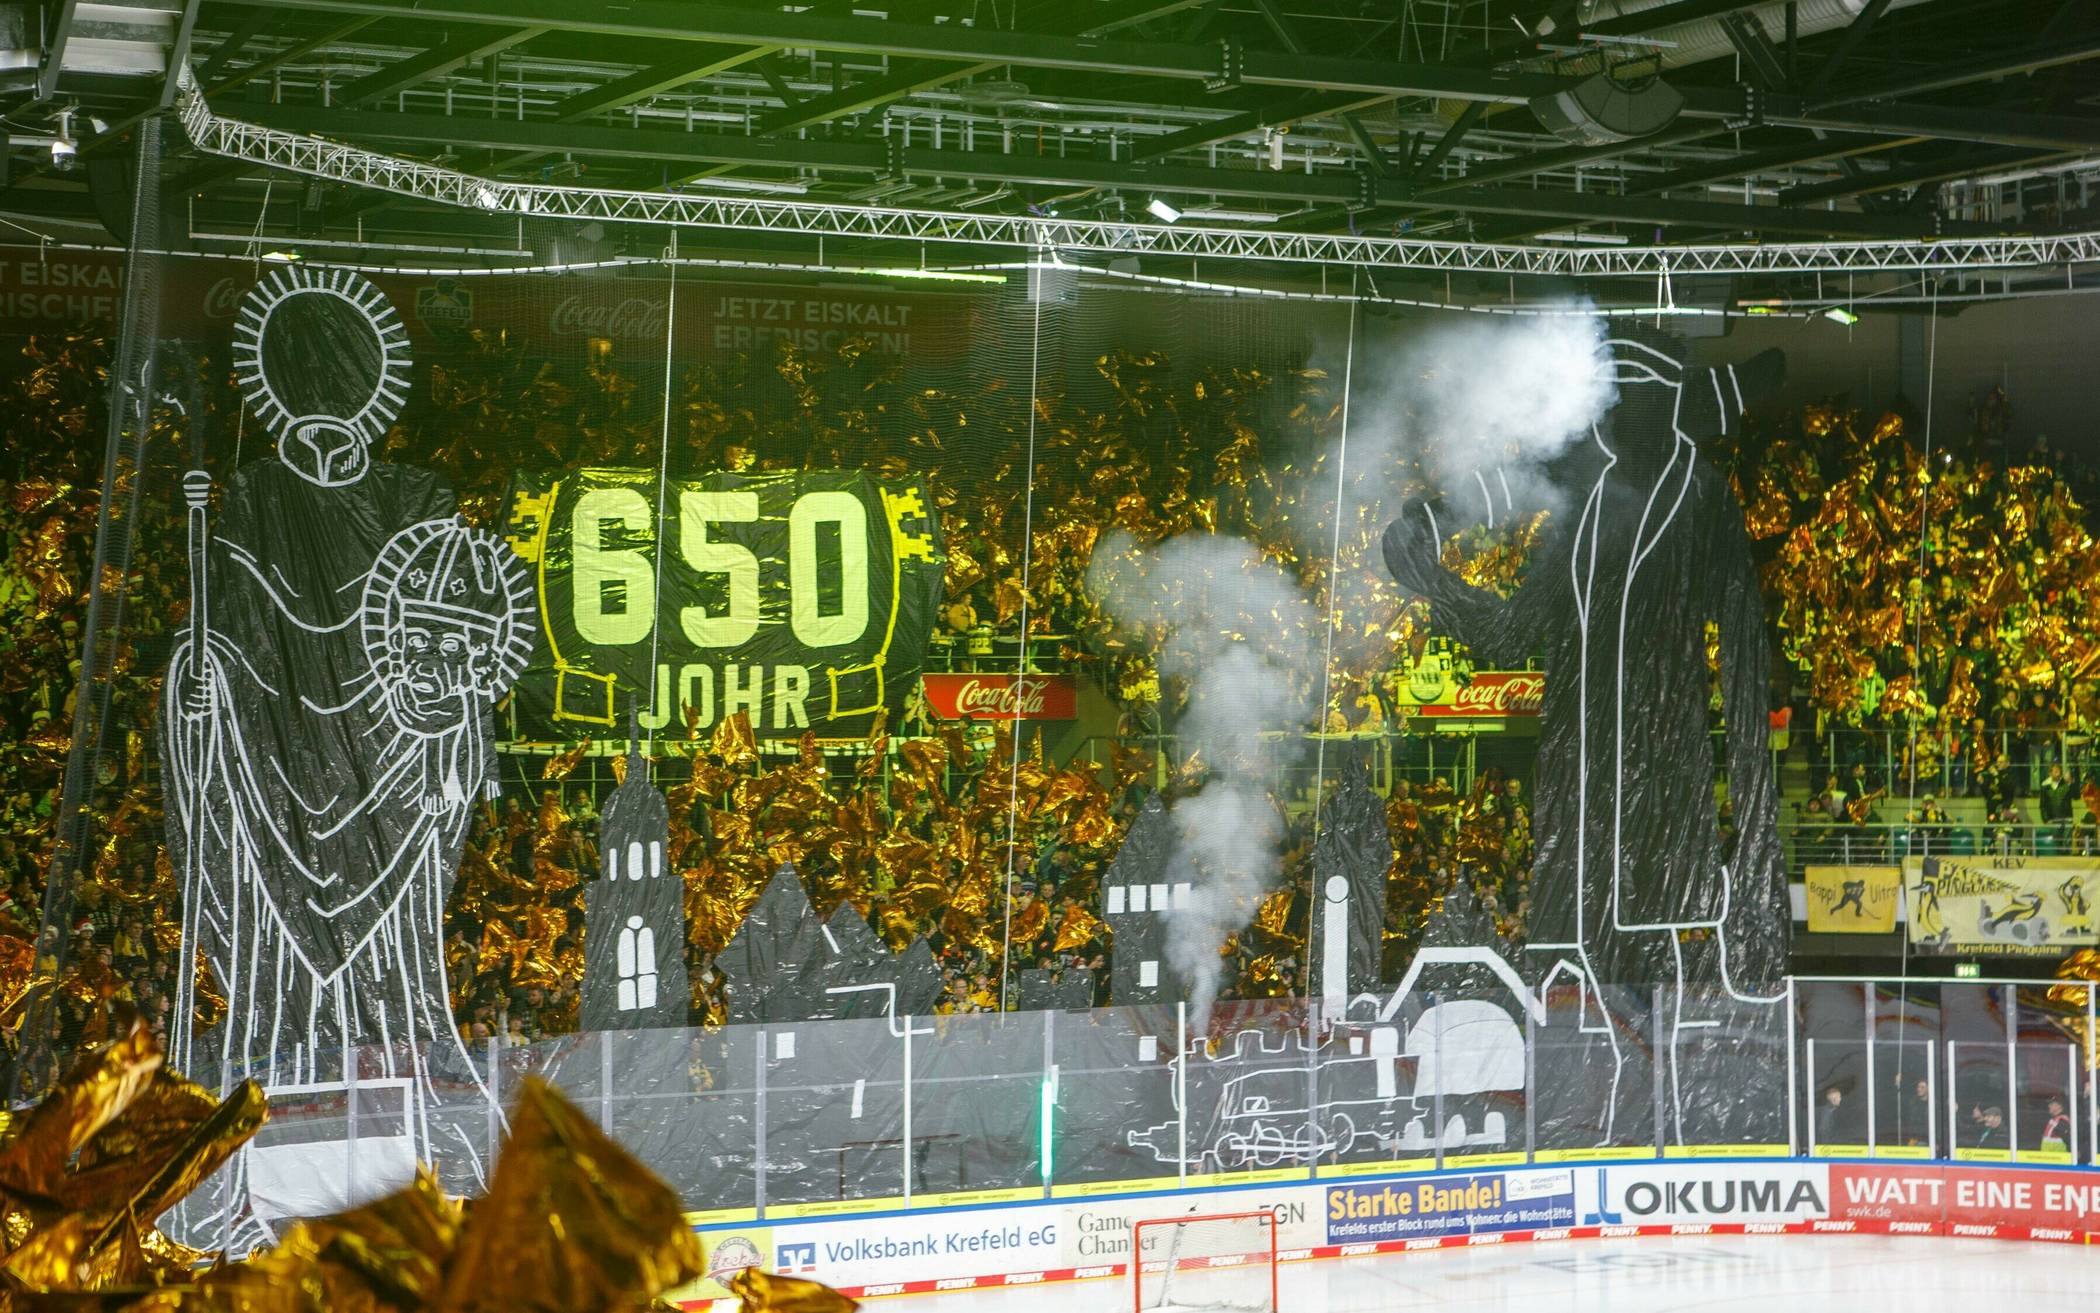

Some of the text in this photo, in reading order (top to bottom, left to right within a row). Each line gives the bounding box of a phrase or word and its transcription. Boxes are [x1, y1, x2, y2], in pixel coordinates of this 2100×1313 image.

[712, 297, 912, 326] JETZT EISKALT
[572, 488, 868, 648] 650
[637, 663, 811, 728] JOHR
[955, 679, 1050, 713] Coca-Cola
[1993, 858, 2026, 869] KEV
[1329, 1179, 1501, 1218] Starke Bande!
[1625, 1180, 1826, 1215] OKUMA
[1845, 1176, 1946, 1206] WATT
[1957, 1180, 2032, 1209] EINE
[1368, 1221, 1396, 1233] erster
[1398, 1218, 1423, 1231] Block
[1424, 1216, 1445, 1228] rund
[1503, 1210, 1518, 1223] die
[826, 1225, 1056, 1263] Volksbank Krefeld eG
[1078, 1235, 1158, 1256] Chaner
